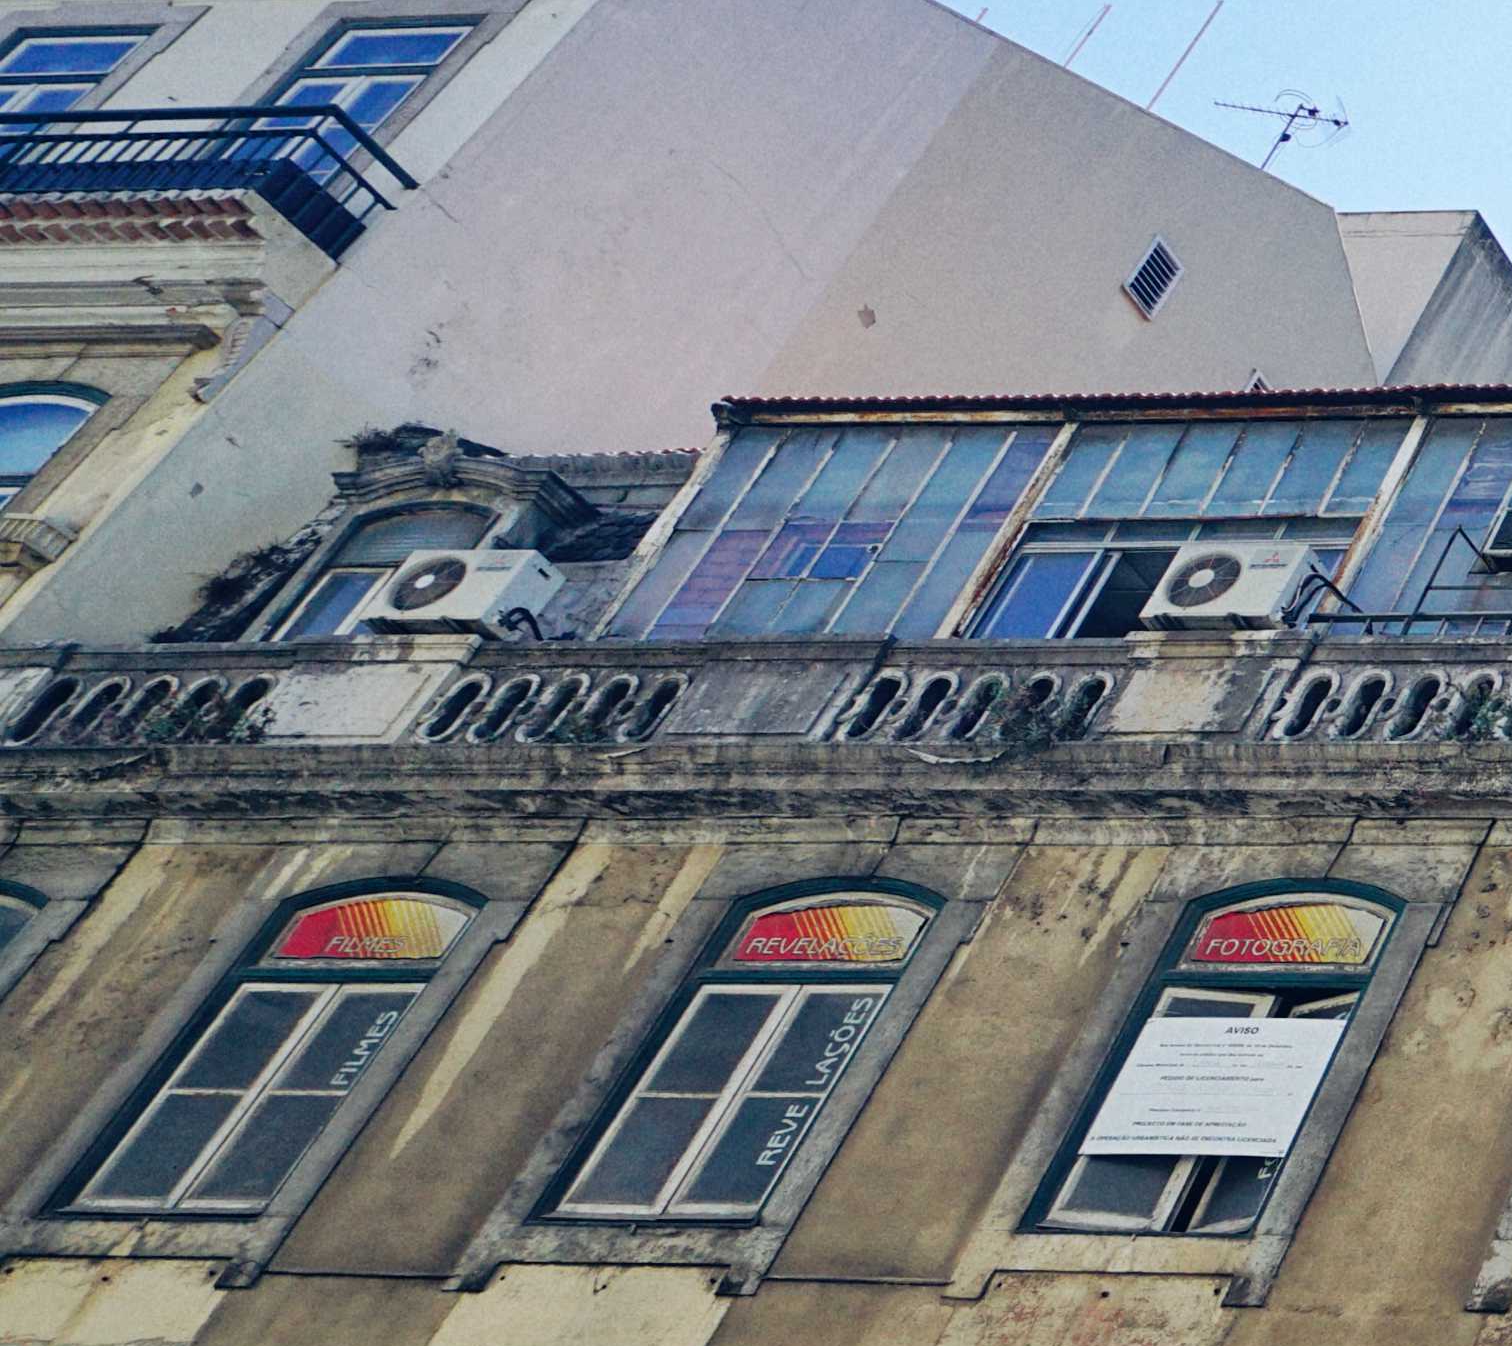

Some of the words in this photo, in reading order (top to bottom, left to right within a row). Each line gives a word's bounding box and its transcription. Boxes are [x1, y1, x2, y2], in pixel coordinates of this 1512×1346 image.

[324, 935, 409, 954] FILMES
[1205, 937, 1362, 957] FOTOGRAFIA
[1224, 1026, 1260, 1035] AVISO
[329, 1011, 398, 1086] FILMES
[755, 1104, 810, 1167] REVE
